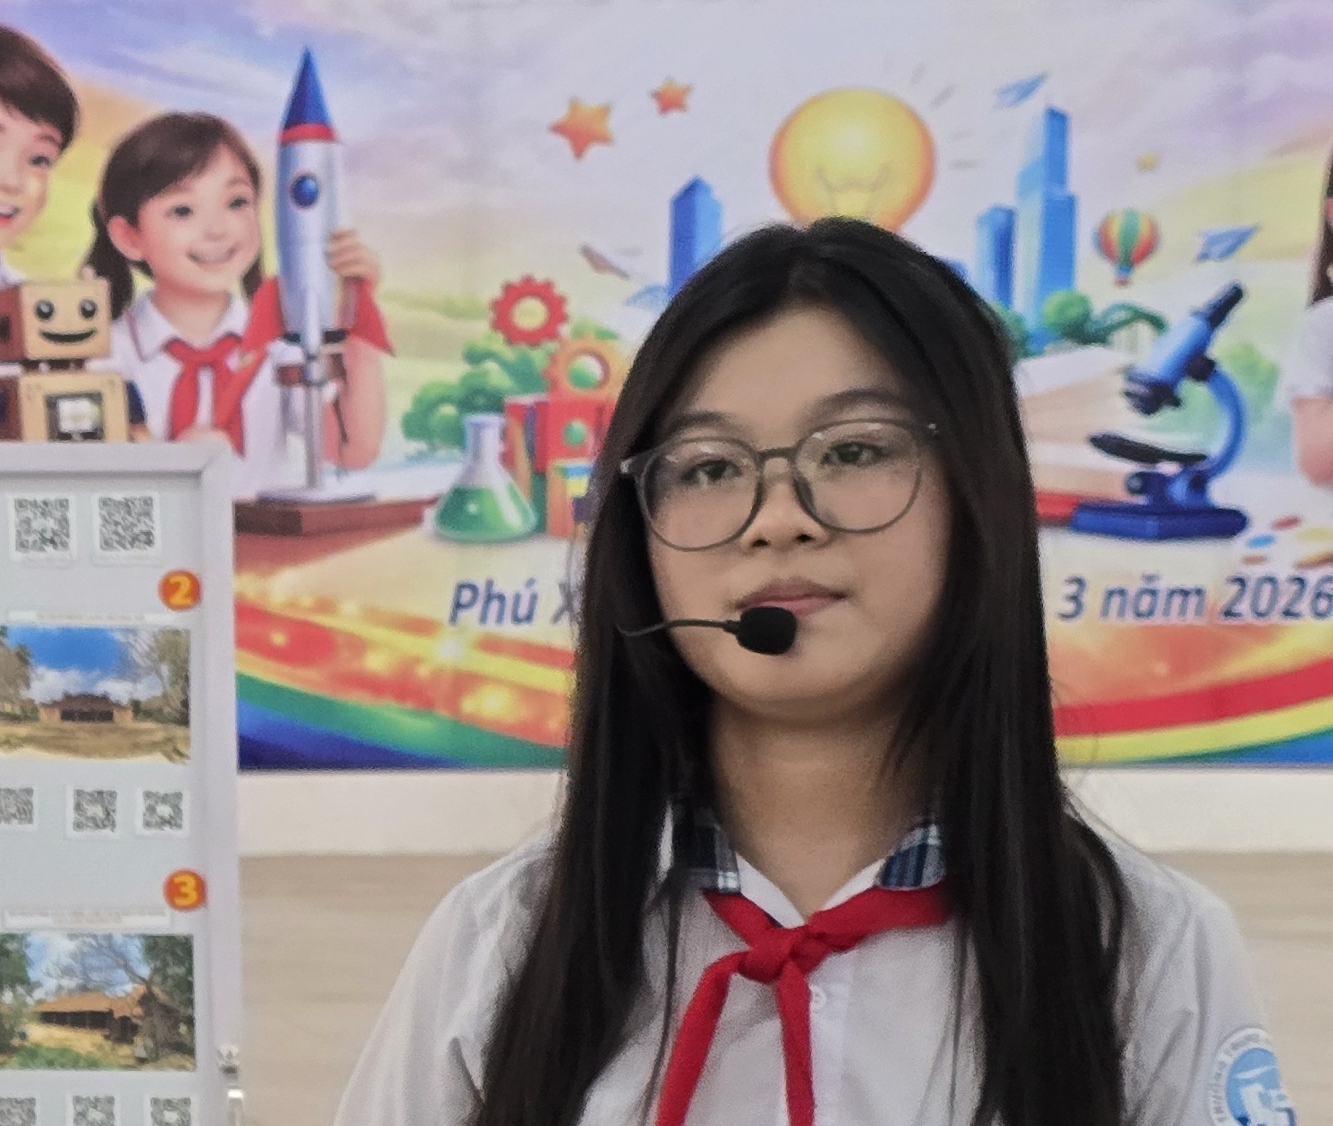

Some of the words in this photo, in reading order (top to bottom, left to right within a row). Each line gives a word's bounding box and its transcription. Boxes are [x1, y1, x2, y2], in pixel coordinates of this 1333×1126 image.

[169, 575, 192, 605] 2
[448, 577, 538, 626] Phú
[1057, 574, 1087, 621] 3
[1099, 571, 1207, 621] năm
[1222, 572, 1333, 621] 2026
[173, 875, 199, 907] 3
